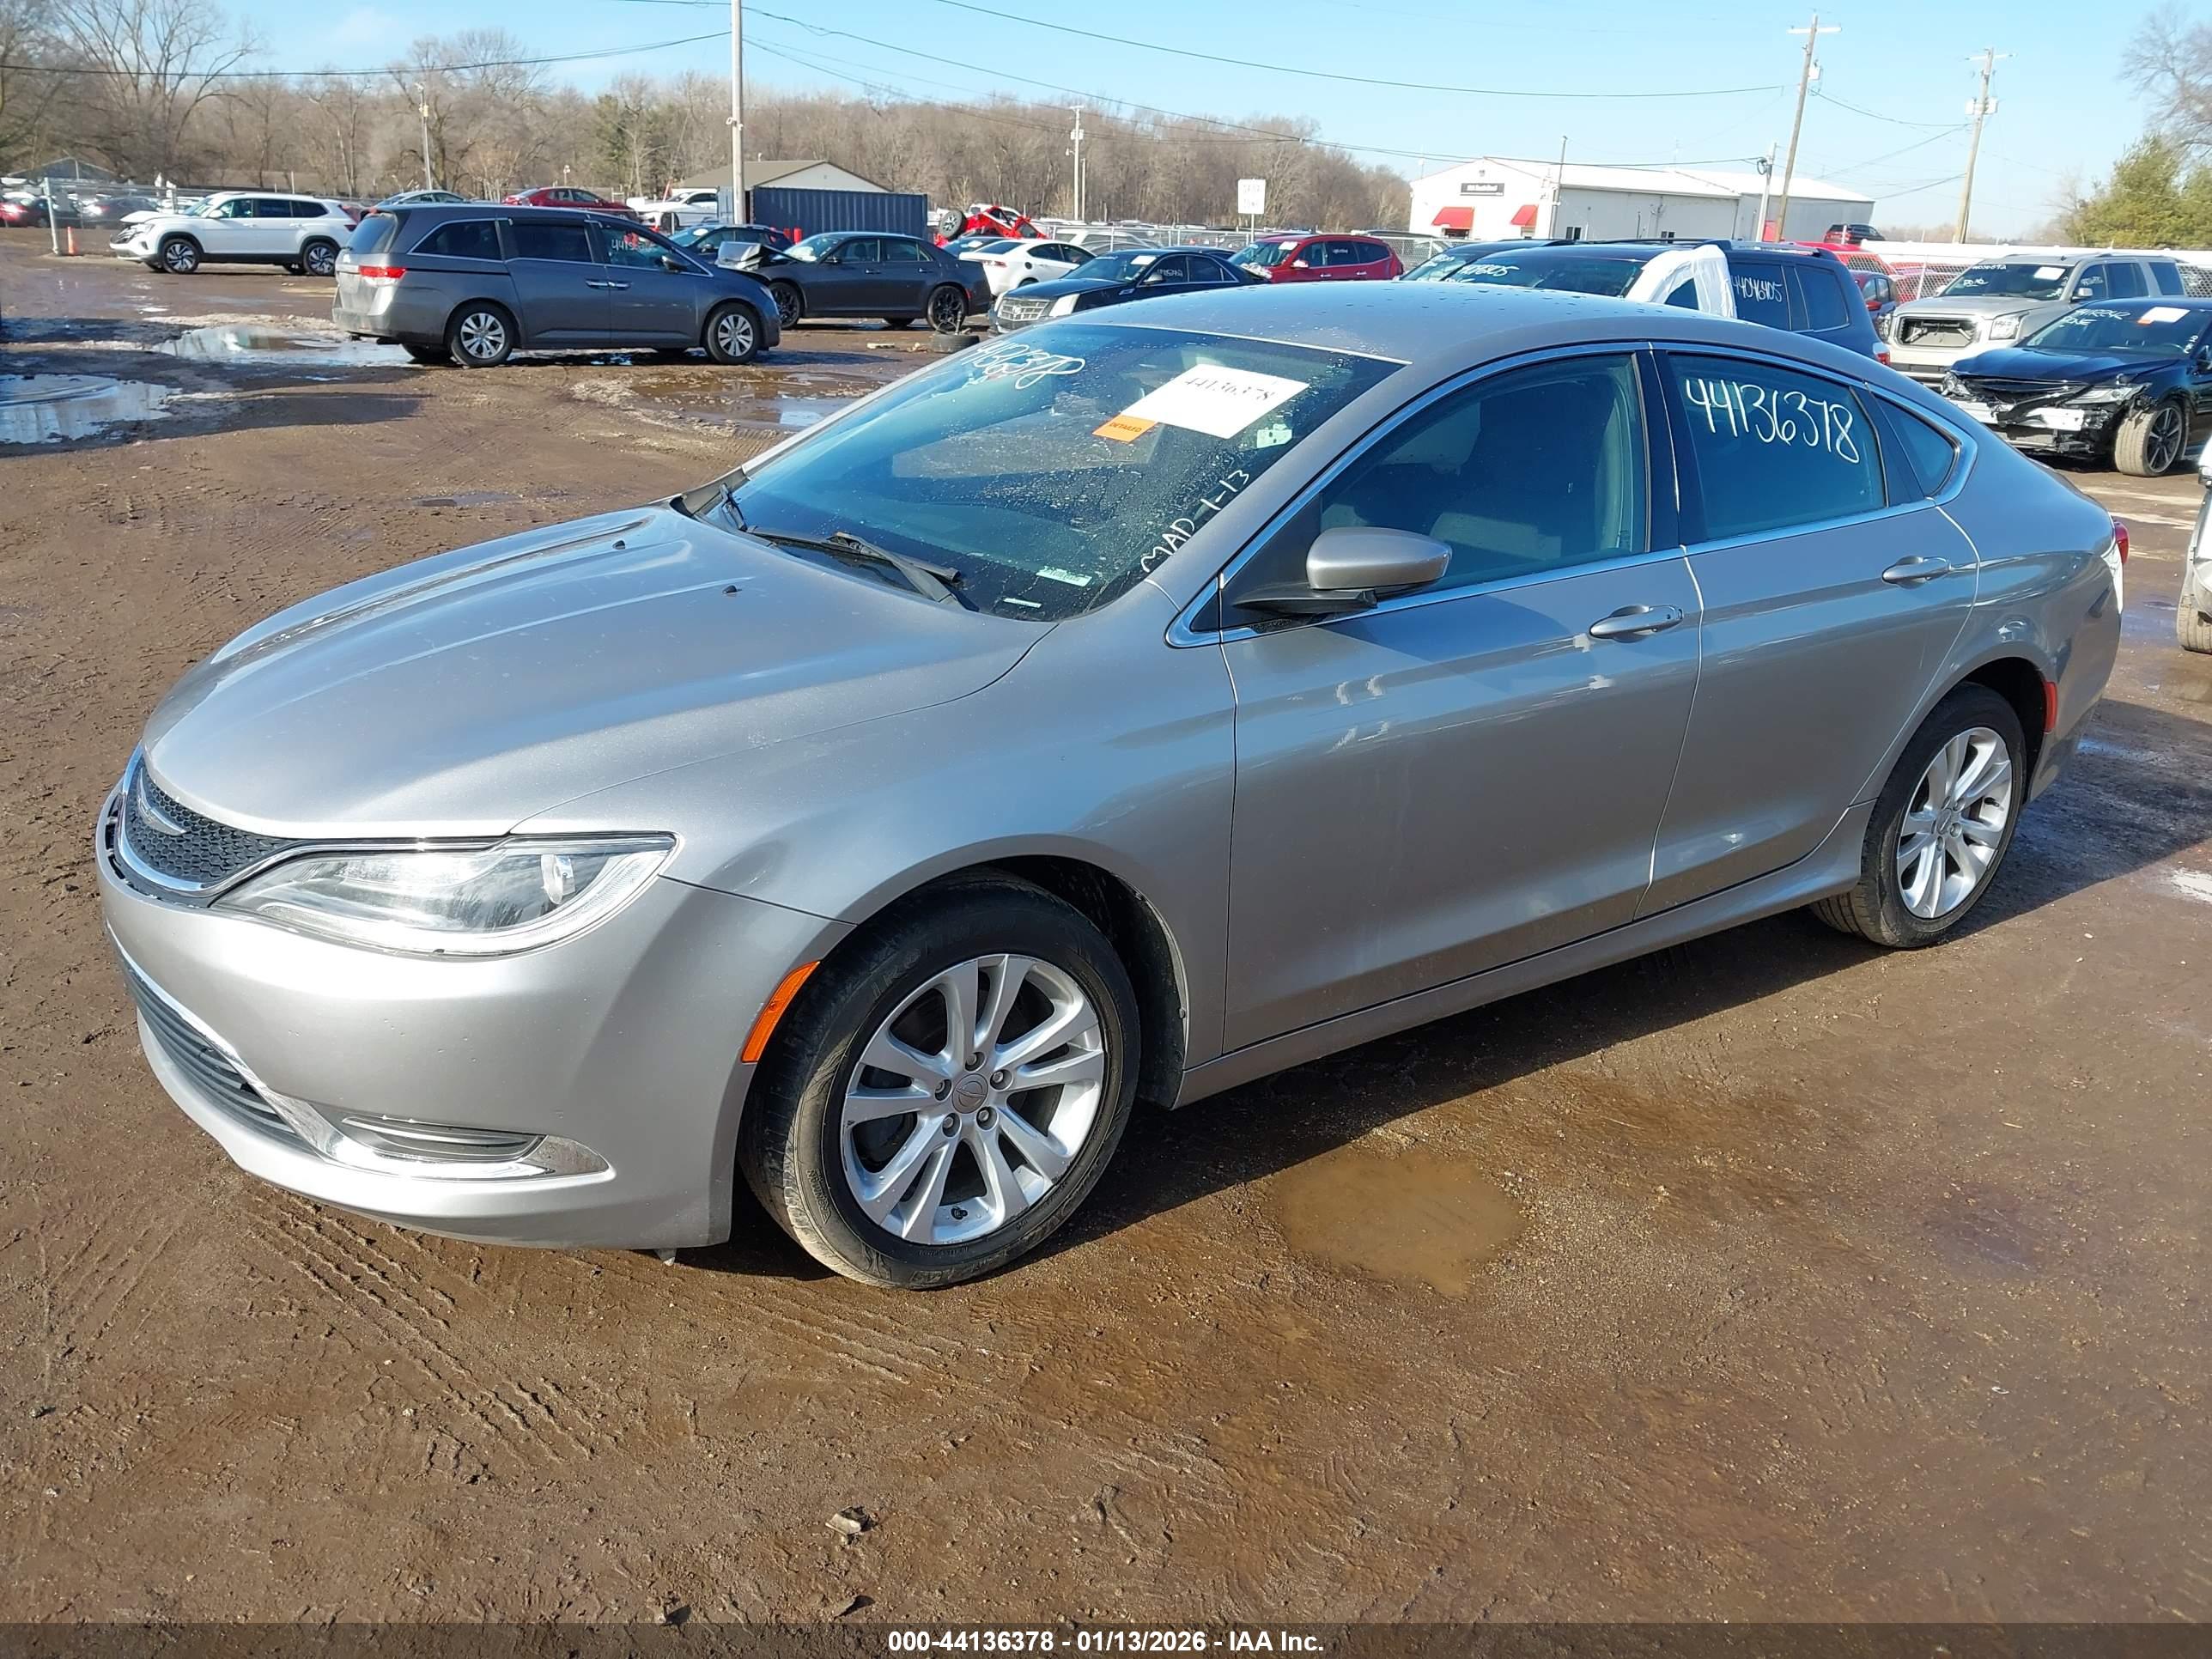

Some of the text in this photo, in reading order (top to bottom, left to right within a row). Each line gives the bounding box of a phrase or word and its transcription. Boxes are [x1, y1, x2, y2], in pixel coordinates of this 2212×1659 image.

[1109, 421, 1143, 434] DETAILED
[1686, 378, 1860, 464] 44136378
[1140, 470, 1250, 574] MAD 1-13
